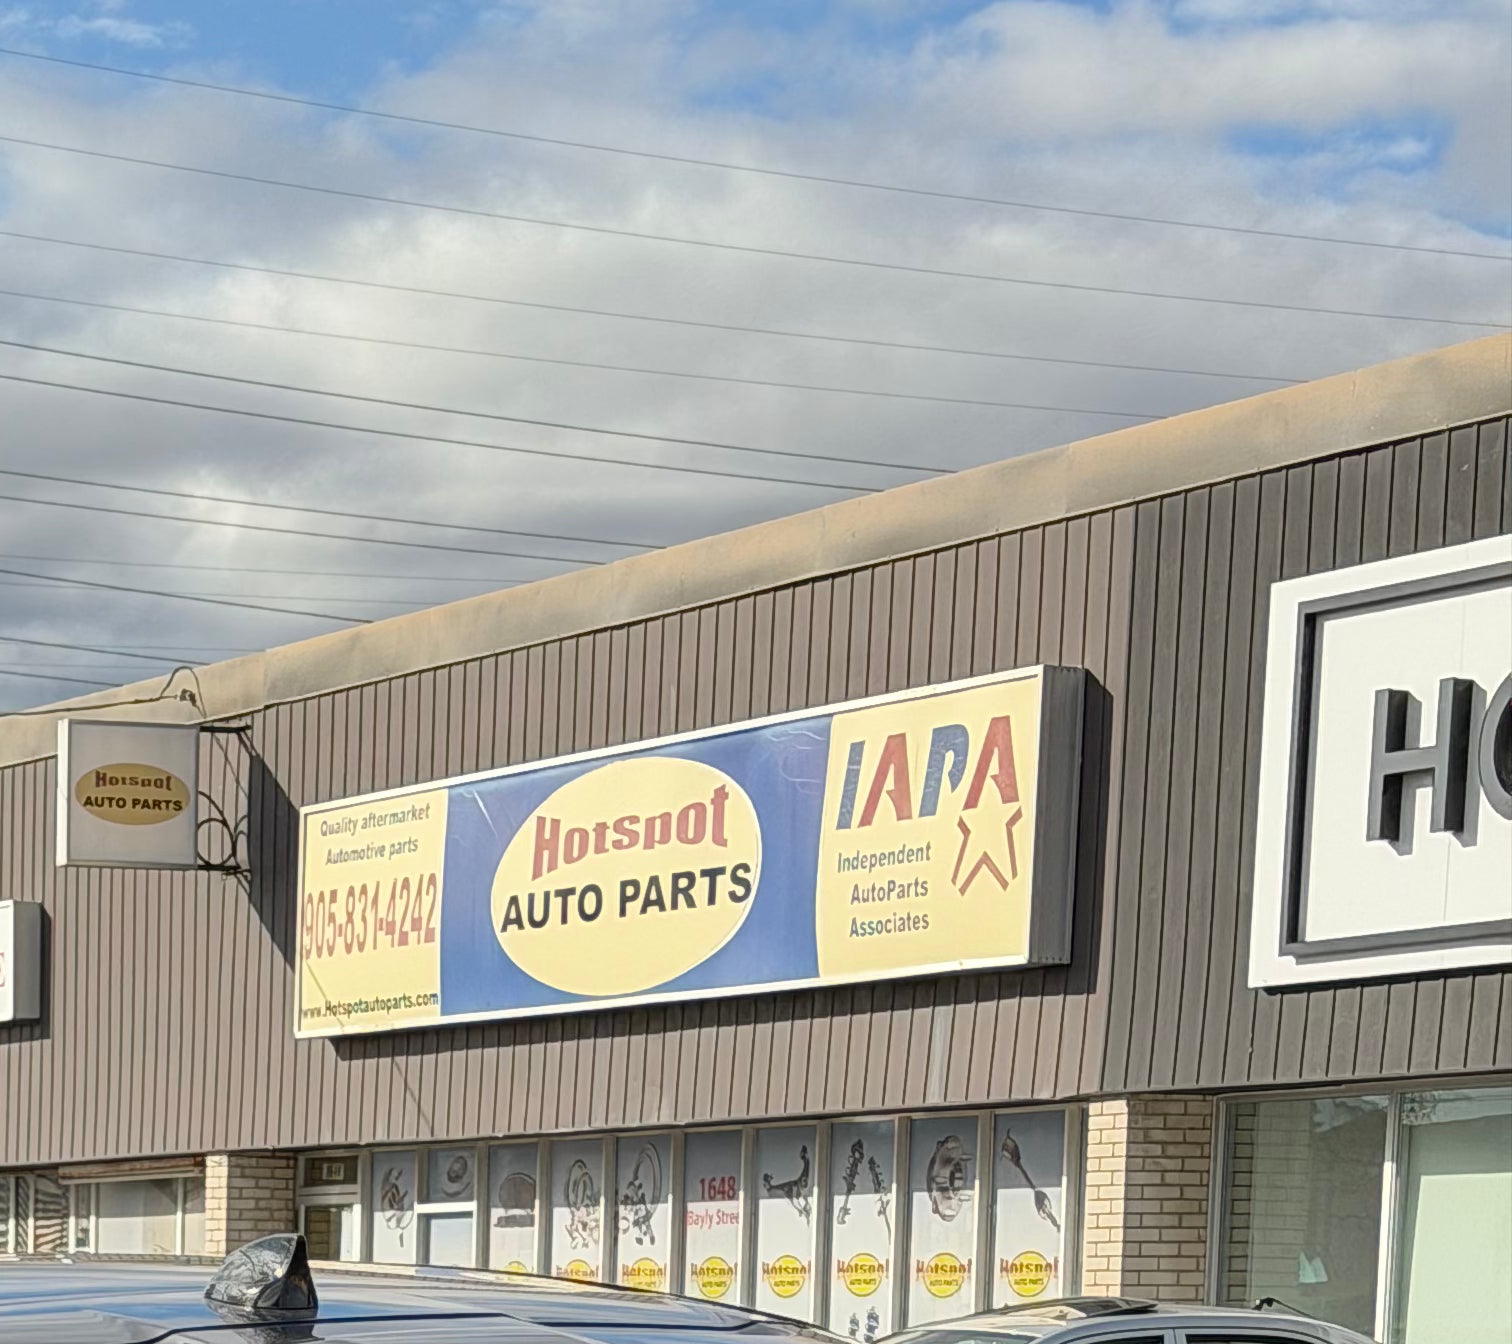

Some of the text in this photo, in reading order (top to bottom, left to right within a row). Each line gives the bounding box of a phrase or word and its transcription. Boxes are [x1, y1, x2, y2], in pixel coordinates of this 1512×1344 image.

[836, 715, 1019, 830] IAPA
[1366, 672, 1512, 855] H
[95, 770, 172, 791] Hotspot
[83, 796, 183, 812] AUTO PARTS
[320, 802, 430, 837] Quality aftermarket
[532, 784, 729, 881] Hotspot
[325, 837, 419, 866] Automotive parts
[837, 841, 931, 873] Independent
[500, 862, 752, 933] AUTO PARTS
[850, 877, 929, 905] AutoParts
[302, 873, 437, 961] 905-831-4242
[849, 912, 930, 938] Associates
[300, 992, 439, 1020] www.Hotspotautoparts.com
[699, 1175, 736, 1201] 1648
